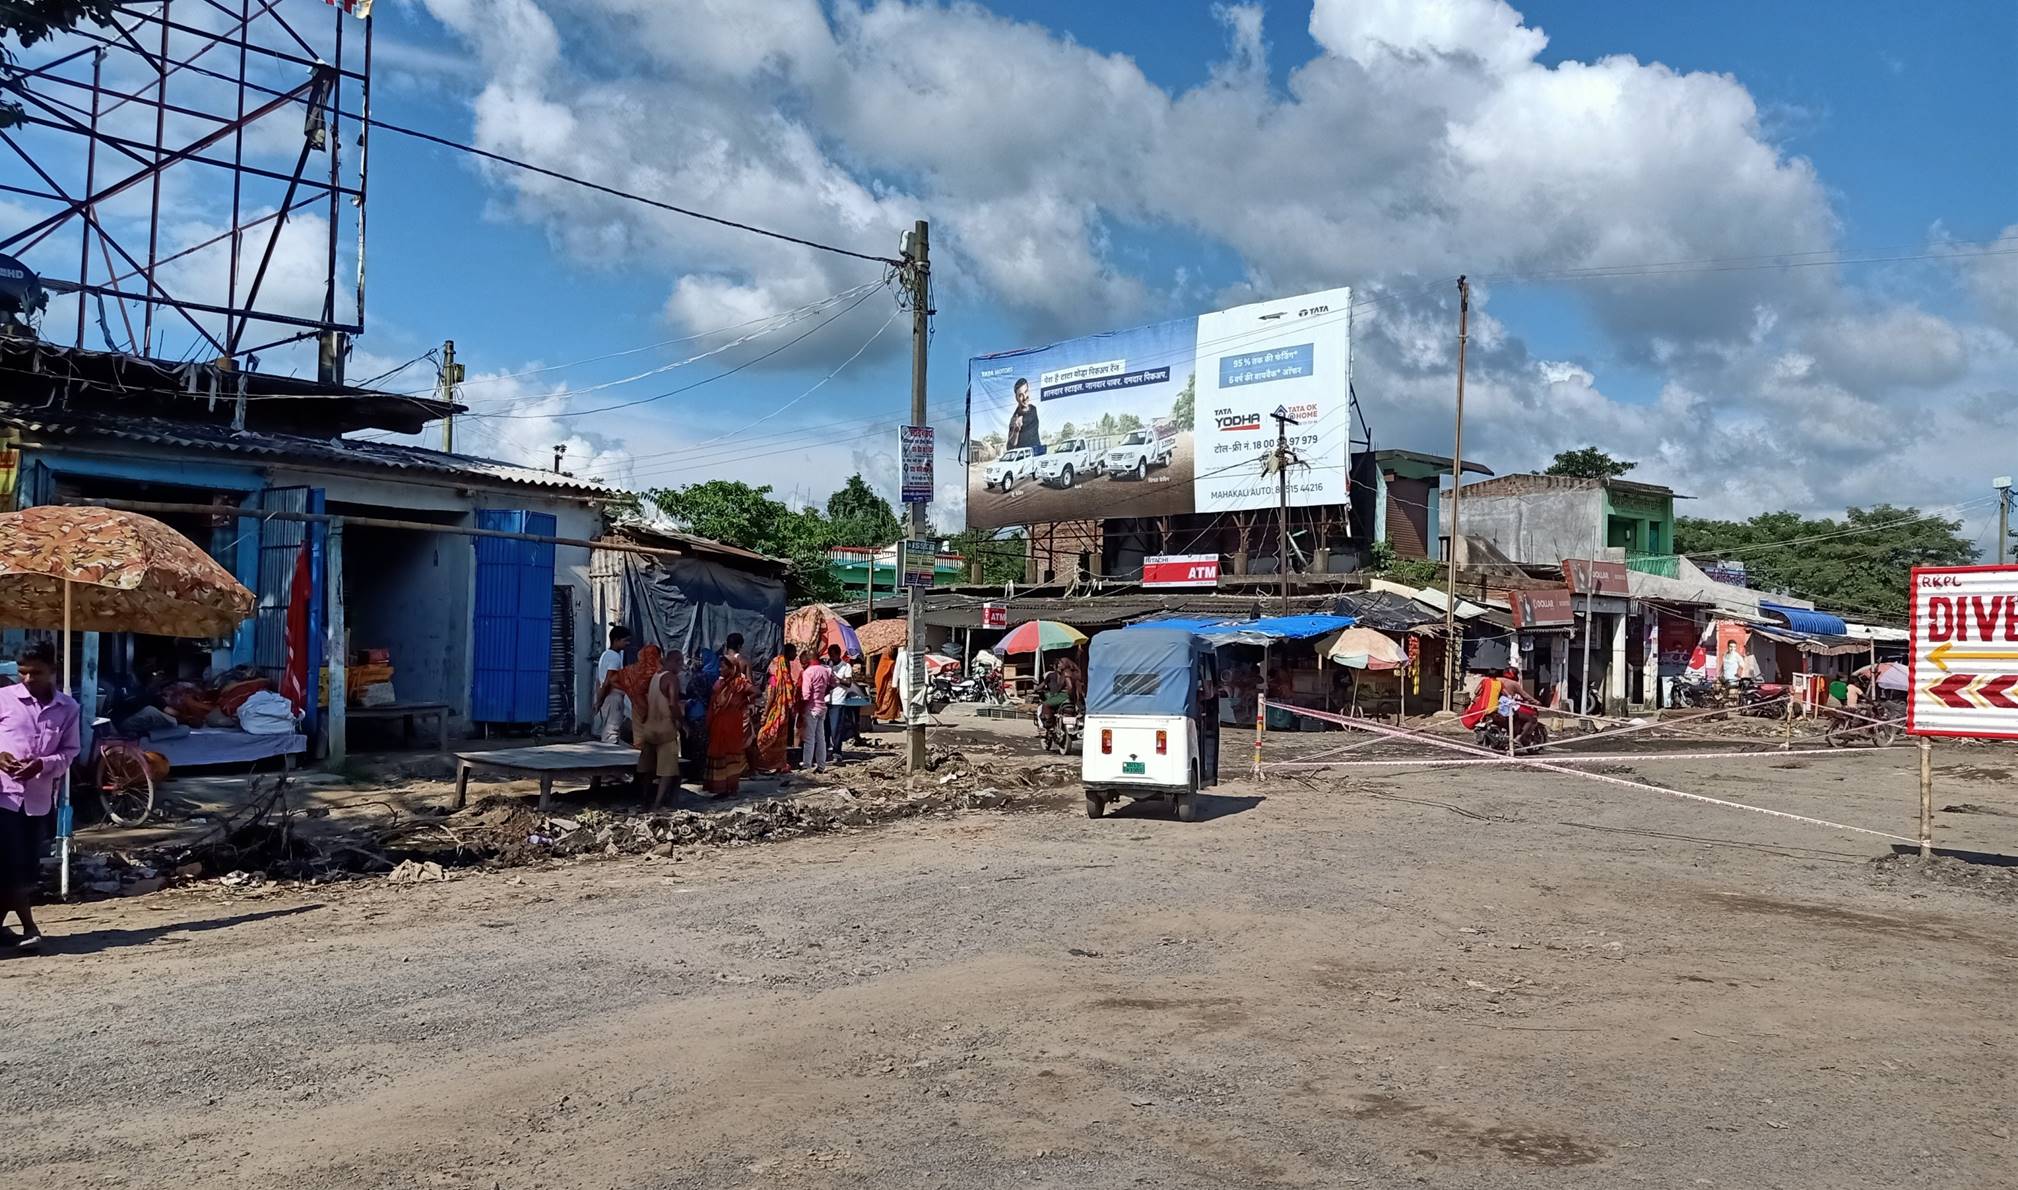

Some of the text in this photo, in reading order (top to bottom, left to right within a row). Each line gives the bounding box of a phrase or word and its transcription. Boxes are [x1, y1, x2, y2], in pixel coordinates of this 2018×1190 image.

[1310, 305, 1329, 315] TATA
[1233, 359, 1243, 368] 95
[1251, 356, 1264, 365] तक
[1264, 353, 1273, 362] की
[1054, 373, 1059, 383] है
[1060, 371, 1073, 381] टाटा
[1088, 366, 1109, 375] पिकअप
[1244, 371, 1254, 381] की
[1043, 387, 1063, 398] शानदार
[1214, 408, 1232, 416] TATA
[1288, 403, 1318, 413] TATA OK
[1215, 413, 1260, 428] YODHA
[1288, 410, 1318, 420] @HOME
[1253, 440, 1262, 449] 18
[1263, 439, 1275, 448] 00
[1289, 437, 1300, 446] 97
[1301, 434, 1318, 445] 979
[1211, 489, 1249, 500] MAHAKALI
[1275, 484, 1298, 494] 8515
[1300, 482, 1323, 492] 44216
[1188, 565, 1216, 579] ATM
[1922, 575, 1962, 588] RKPL
[991, 612, 1007, 621] ATM
